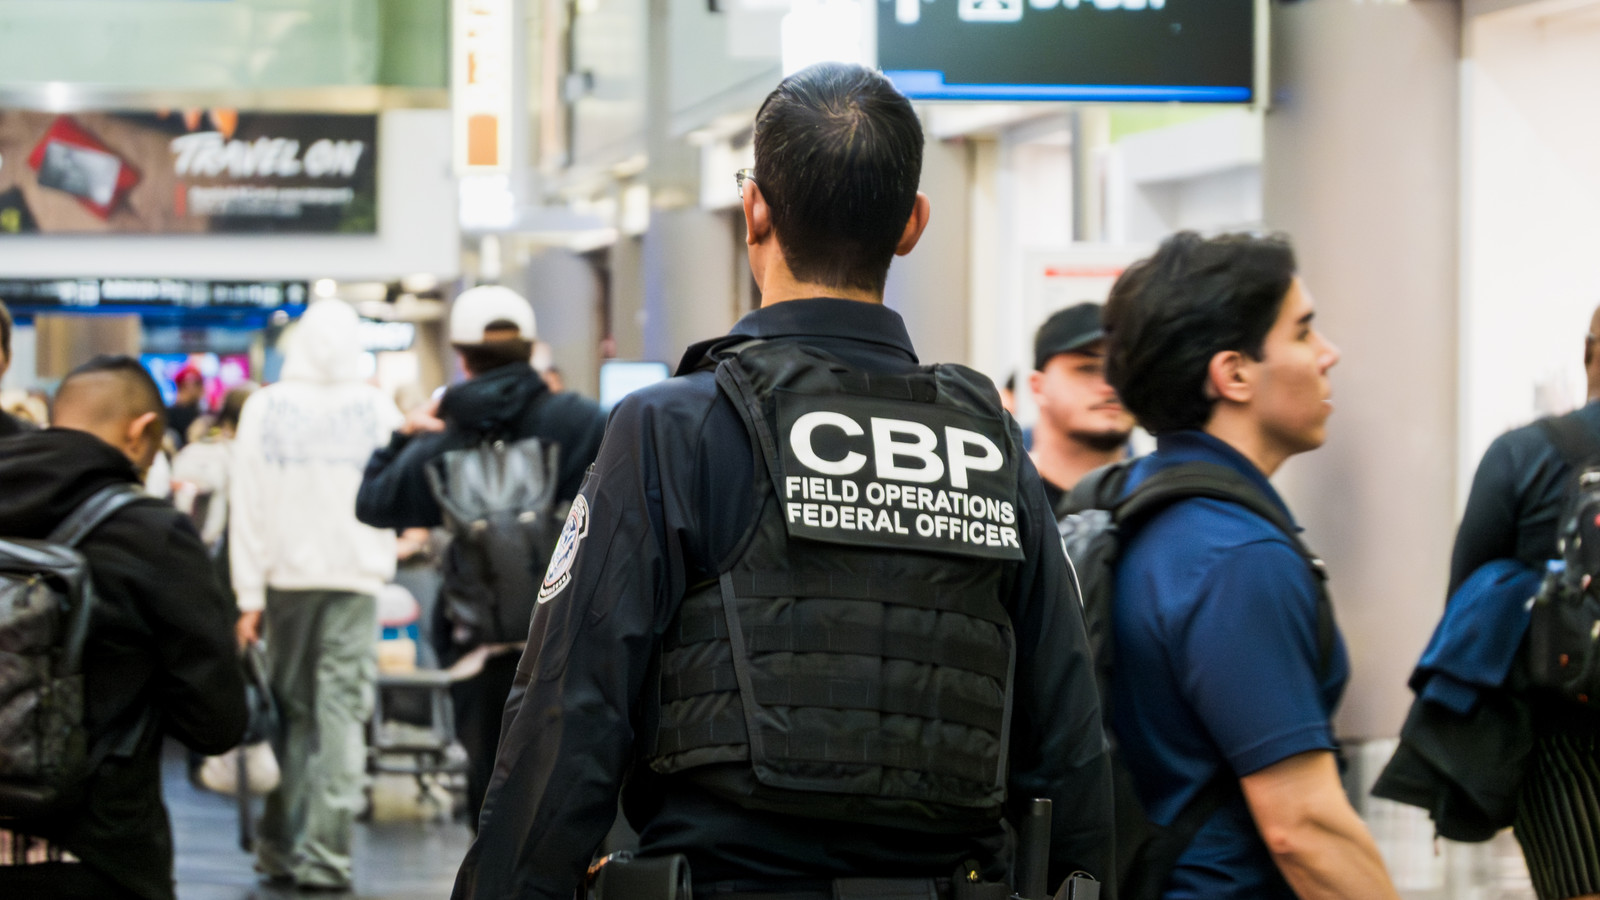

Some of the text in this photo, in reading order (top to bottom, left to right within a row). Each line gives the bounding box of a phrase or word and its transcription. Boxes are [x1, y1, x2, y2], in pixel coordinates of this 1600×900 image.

[170, 131, 365, 178] TRAVEL ON
[789, 411, 1004, 489] CBP
[785, 476, 1016, 525] FIELD OPERATIONS
[787, 502, 1020, 549] FEDERAL OFFICER
